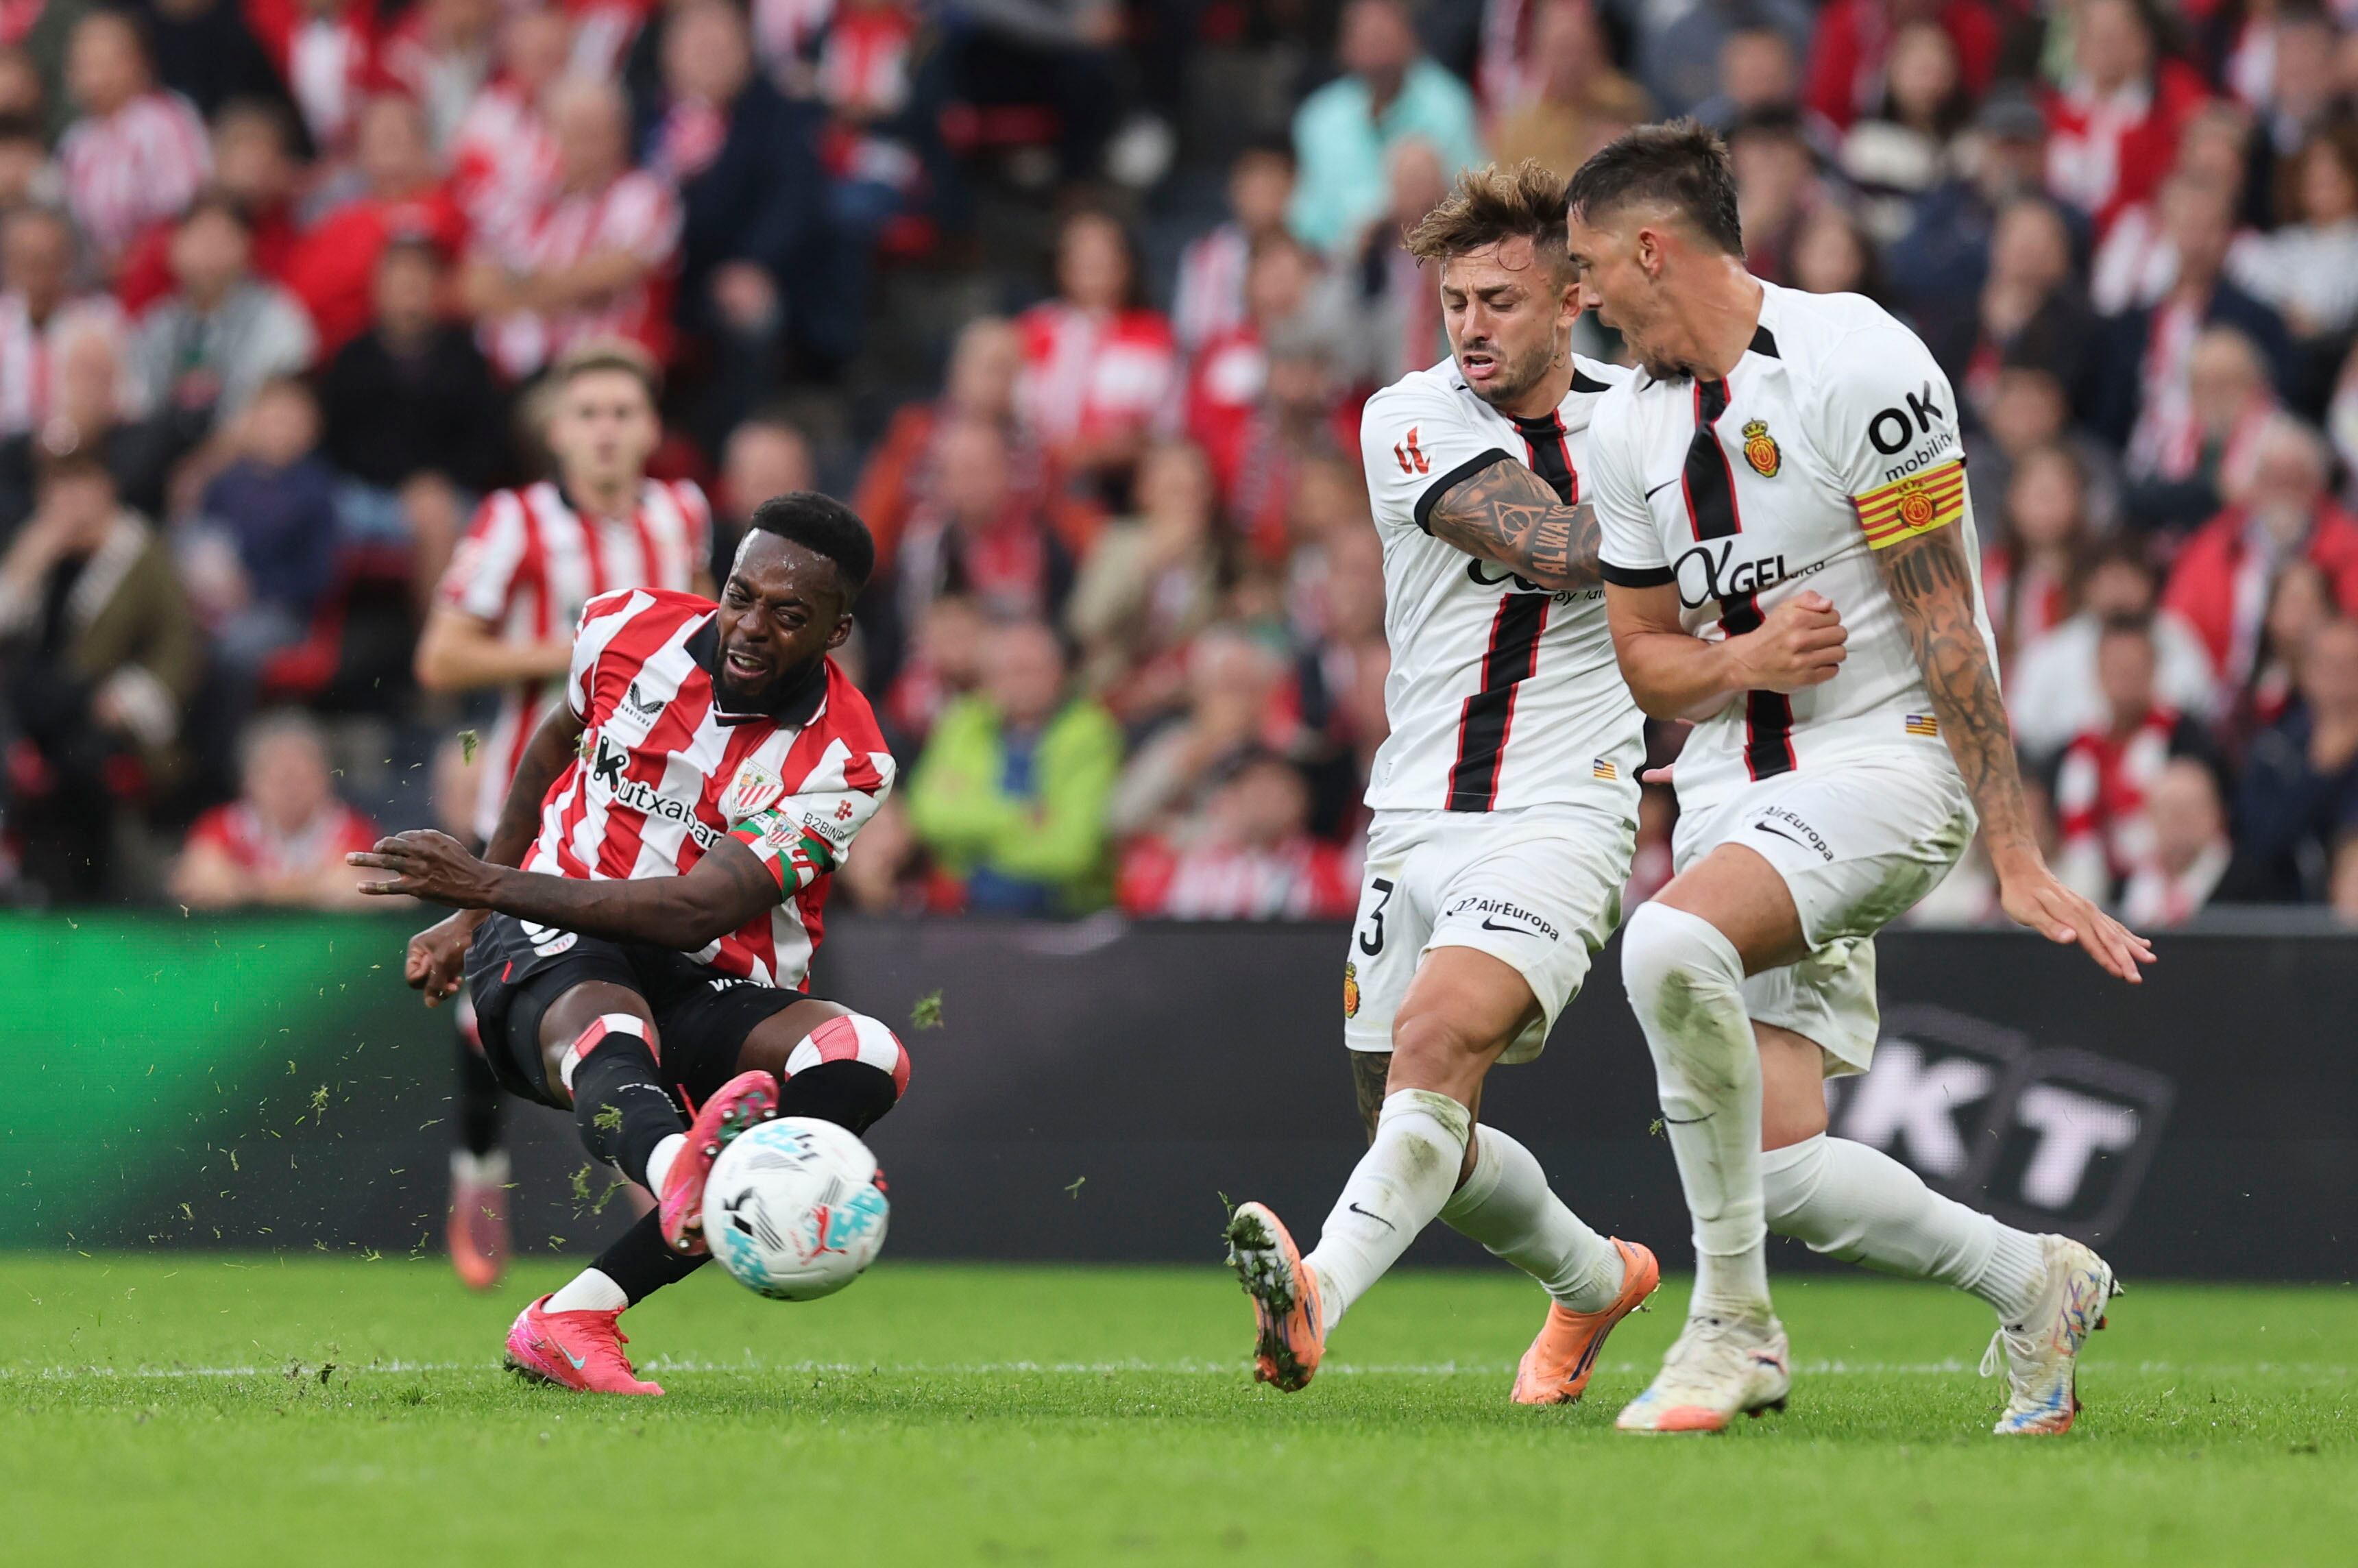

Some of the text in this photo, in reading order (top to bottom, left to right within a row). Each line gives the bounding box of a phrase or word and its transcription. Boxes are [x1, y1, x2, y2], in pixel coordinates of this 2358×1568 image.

[1869, 380, 1943, 455] OK
[1531, 505, 1579, 575] ALWAYS
[593, 735, 722, 848] Kutxaban
[1359, 877, 1394, 956] 3
[1476, 900, 1559, 942] AirEuropa
